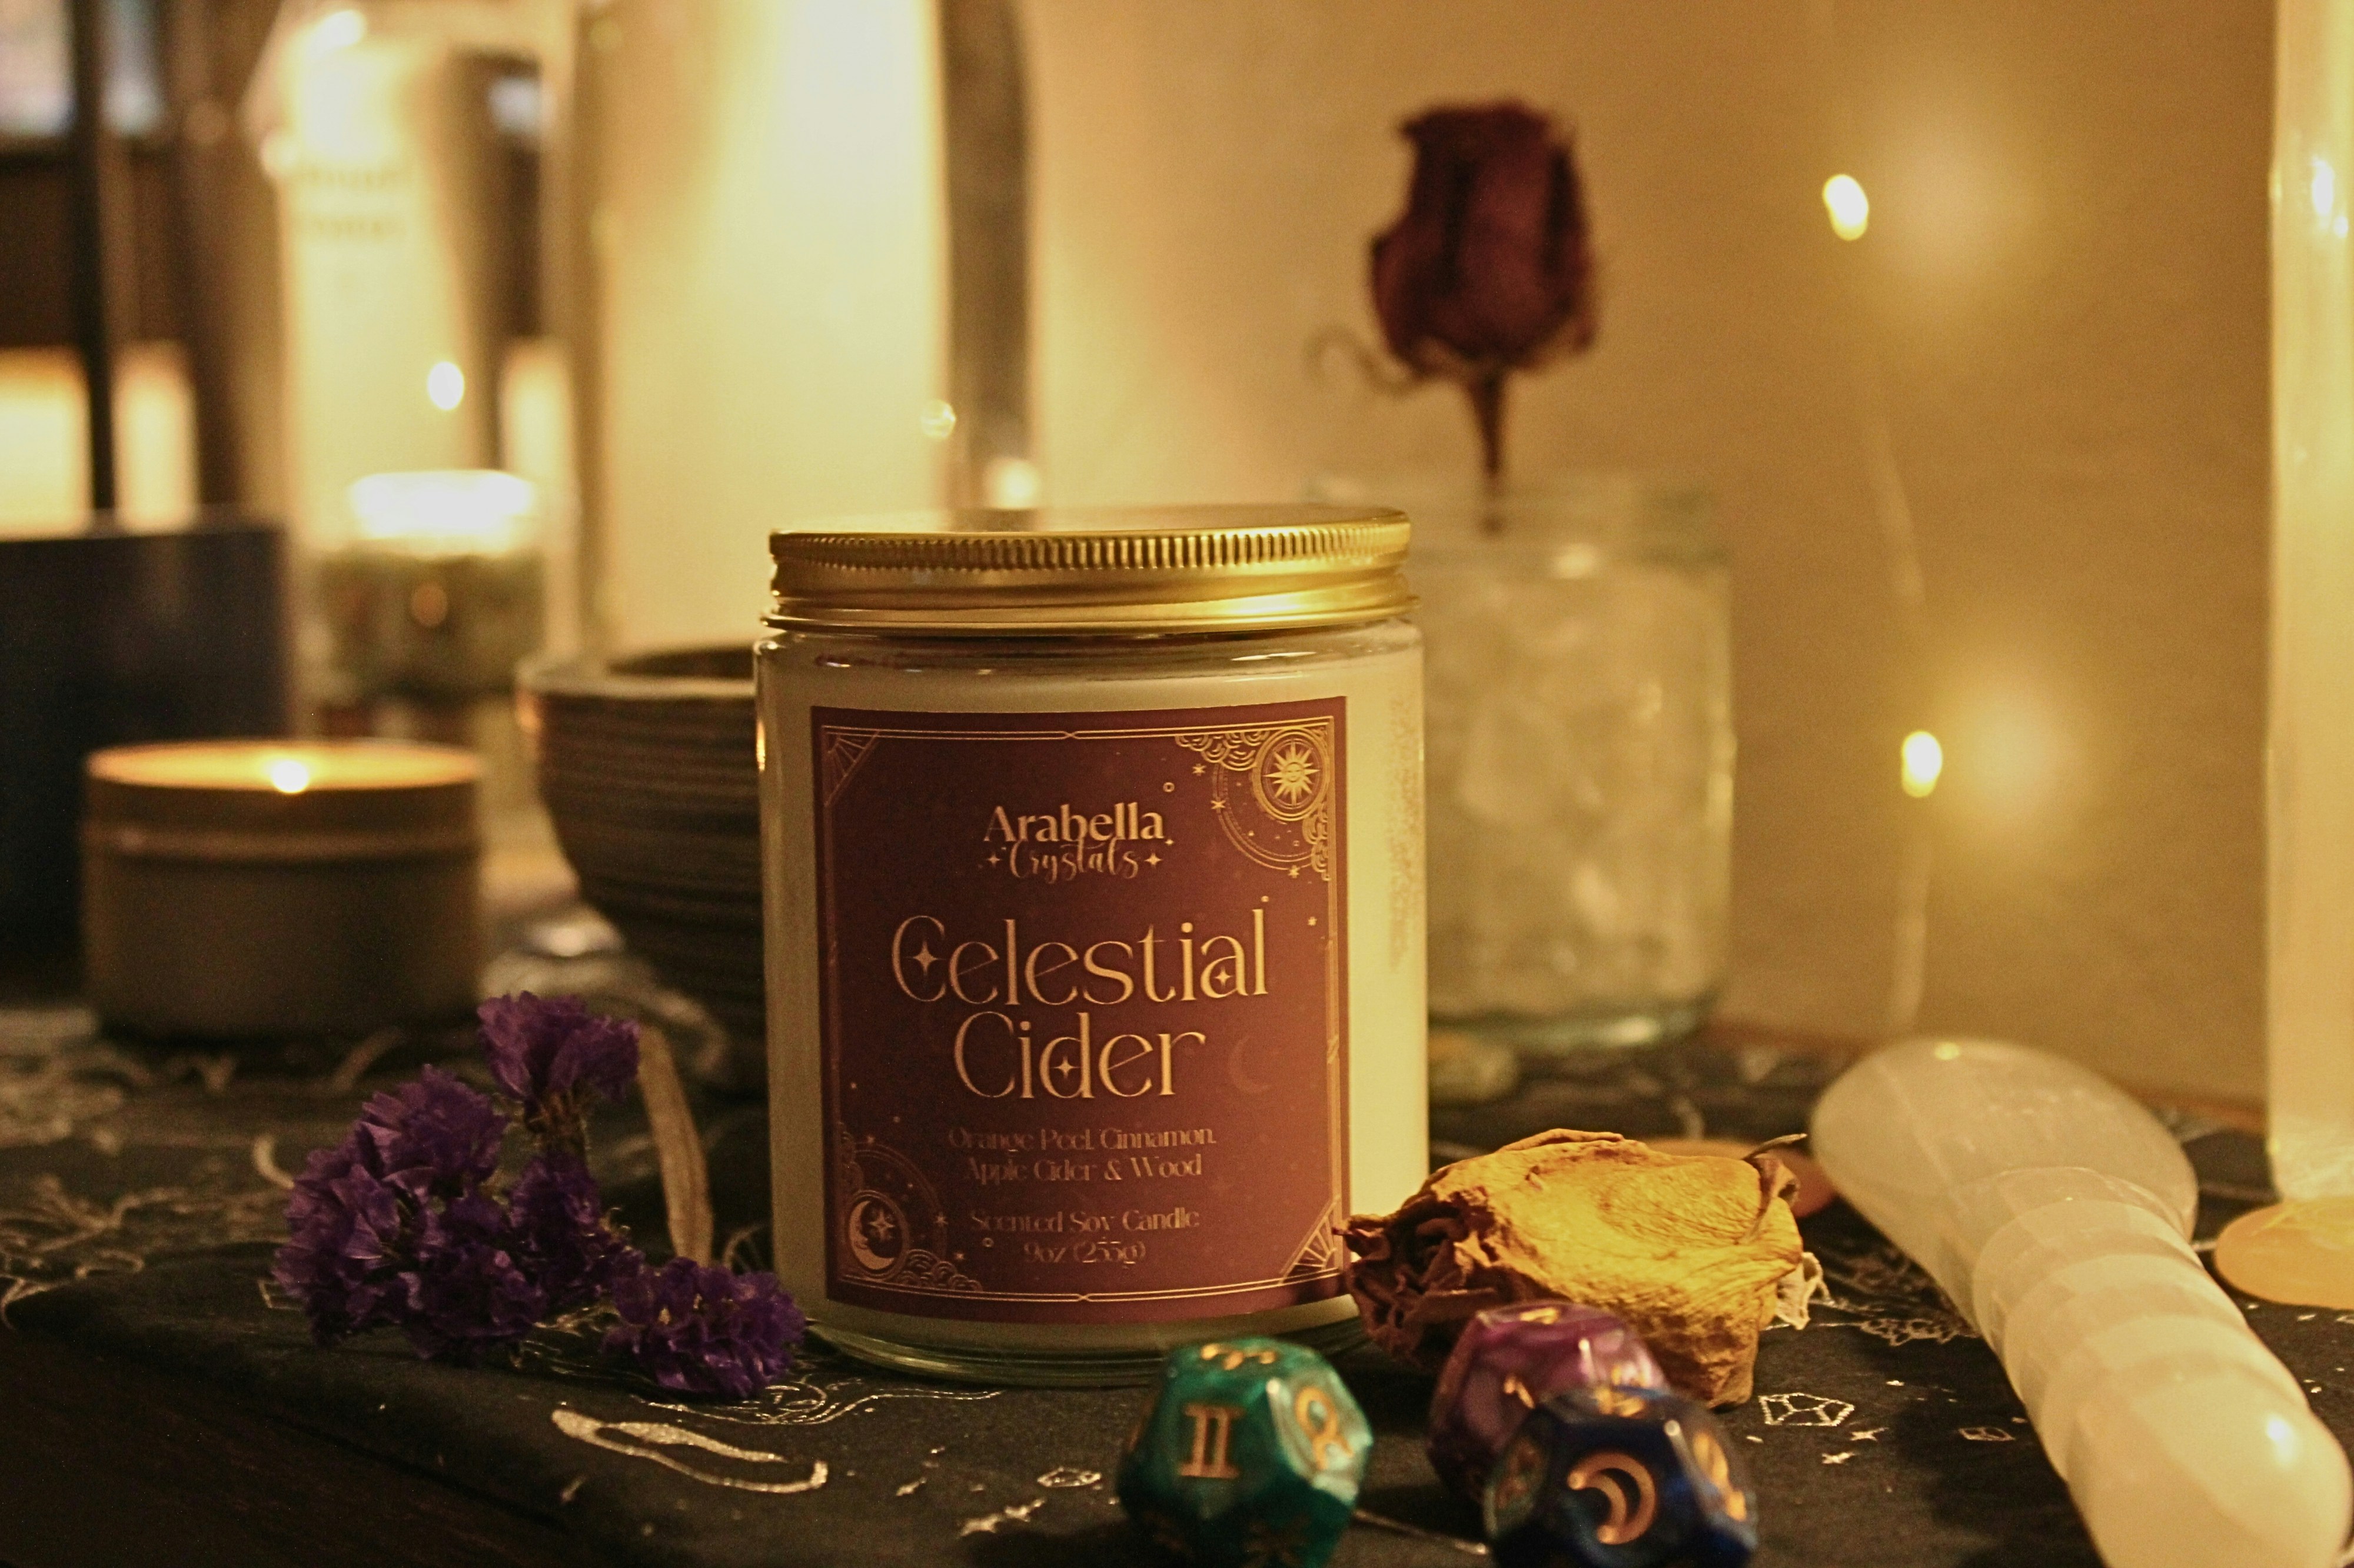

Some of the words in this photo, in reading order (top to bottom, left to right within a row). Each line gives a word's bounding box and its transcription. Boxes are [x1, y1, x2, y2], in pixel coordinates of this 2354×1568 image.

[982, 801, 1165, 842] Arabella
[1009, 837, 1141, 884] Crystals
[892, 908, 1269, 1006] Celestial
[953, 1011, 1206, 1098] Cider
[948, 1127, 1035, 1156] Orange
[963, 1157, 1028, 1186] Apple
[1034, 1158, 1098, 1180] Cider
[1103, 1158, 1123, 1180] &
[1130, 1153, 1202, 1178] Wood
[970, 1210, 1063, 1232] Scented
[1069, 1210, 1115, 1239] Soy
[1122, 1207, 1200, 1231] Candle
